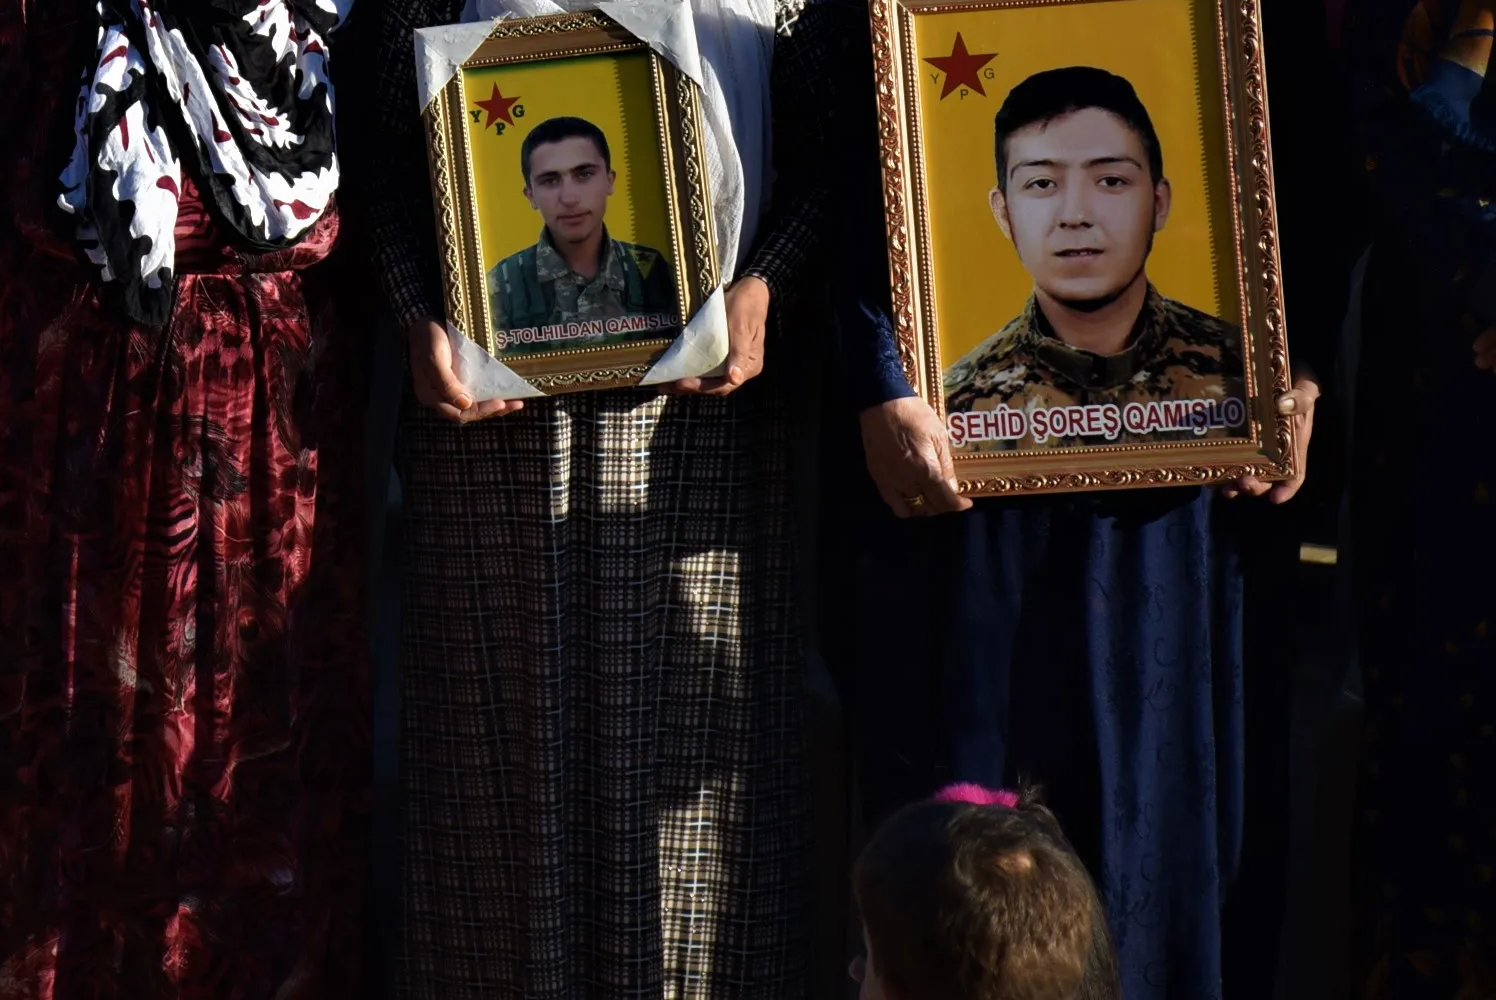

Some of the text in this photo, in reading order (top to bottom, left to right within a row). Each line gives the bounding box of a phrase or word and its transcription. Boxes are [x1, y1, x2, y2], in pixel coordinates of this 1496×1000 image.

[495, 319, 604, 349] Ş-TOLHILDAN
[948, 397, 1245, 447] ŞEHÎD ŞOREŞ QAMIŞLO
